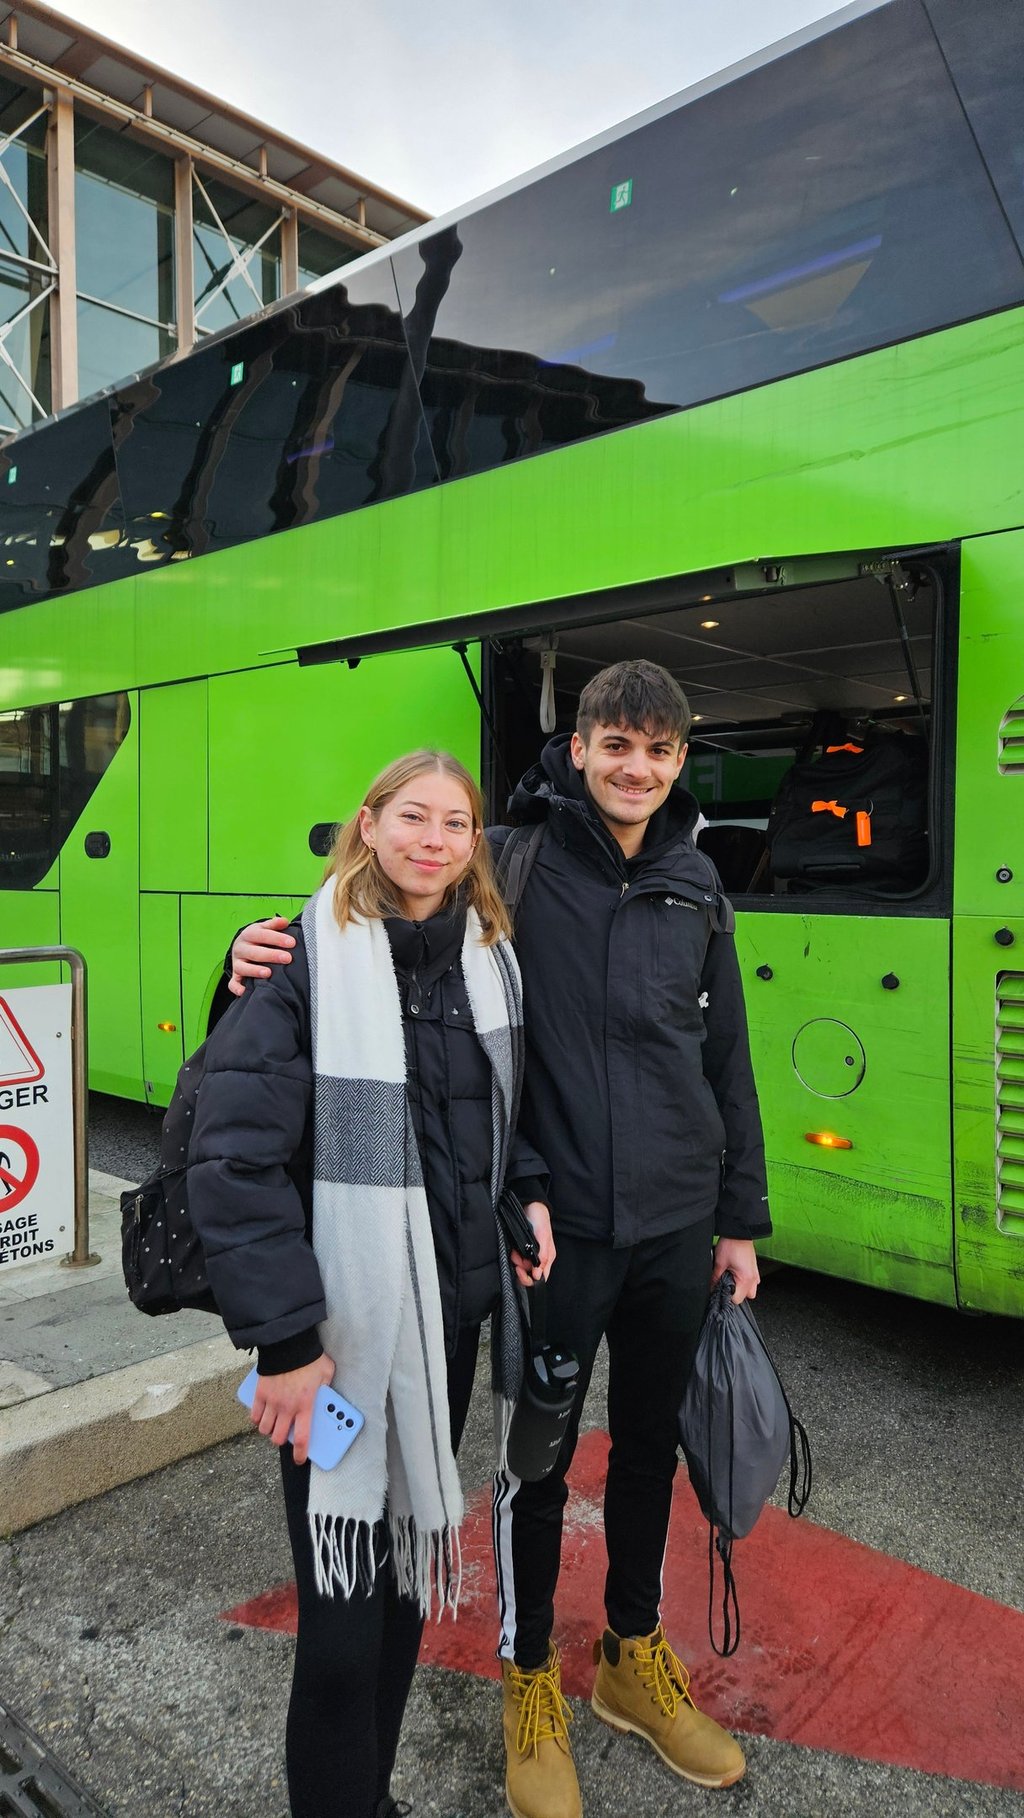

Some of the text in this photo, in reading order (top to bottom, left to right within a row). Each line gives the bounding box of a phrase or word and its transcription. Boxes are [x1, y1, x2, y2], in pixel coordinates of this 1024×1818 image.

[0, 1085, 49, 1110] GER
[0, 1214, 38, 1233] AGE
[0, 1228, 39, 1249] RDIT
[0, 1239, 54, 1264] ÉTONS
